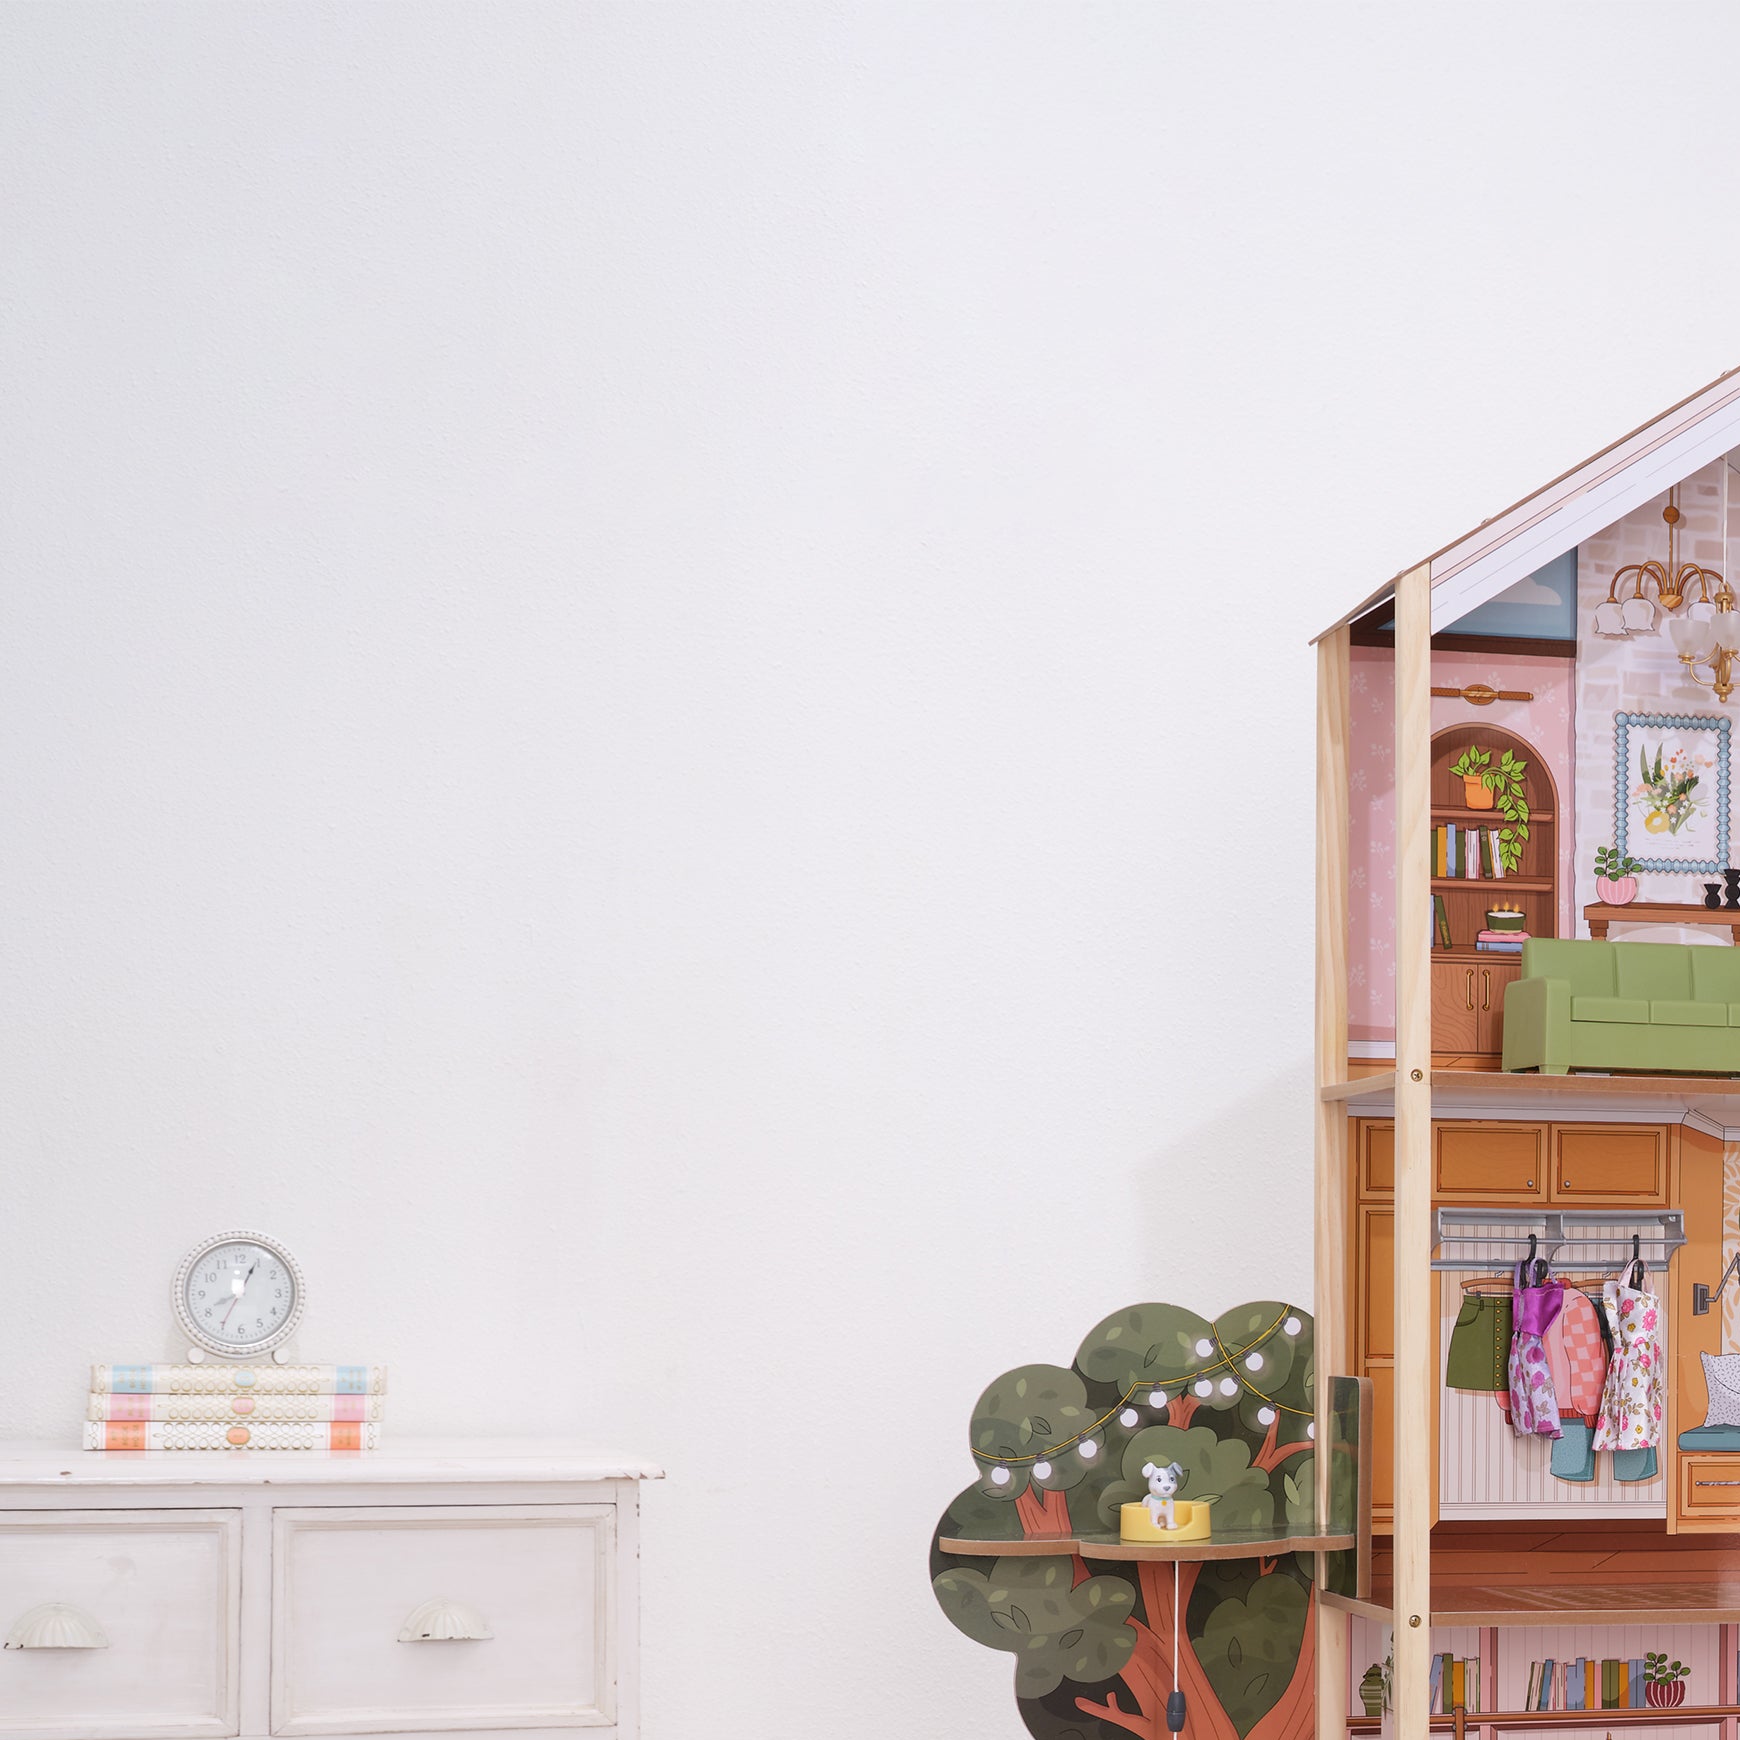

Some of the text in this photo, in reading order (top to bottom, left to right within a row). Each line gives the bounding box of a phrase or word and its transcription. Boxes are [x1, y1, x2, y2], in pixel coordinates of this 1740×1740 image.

[234, 1254, 247, 1264] 12
[216, 1260, 228, 1270] 11
[204, 1272, 217, 1283] 10
[269, 1270, 277, 1280] 2
[198, 1290, 206, 1300] 9
[274, 1288, 282, 1299] 3
[204, 1307, 213, 1318] 8
[269, 1306, 277, 1316] 4
[256, 1318, 264, 1329] 5
[237, 1323, 246, 1335] 6
